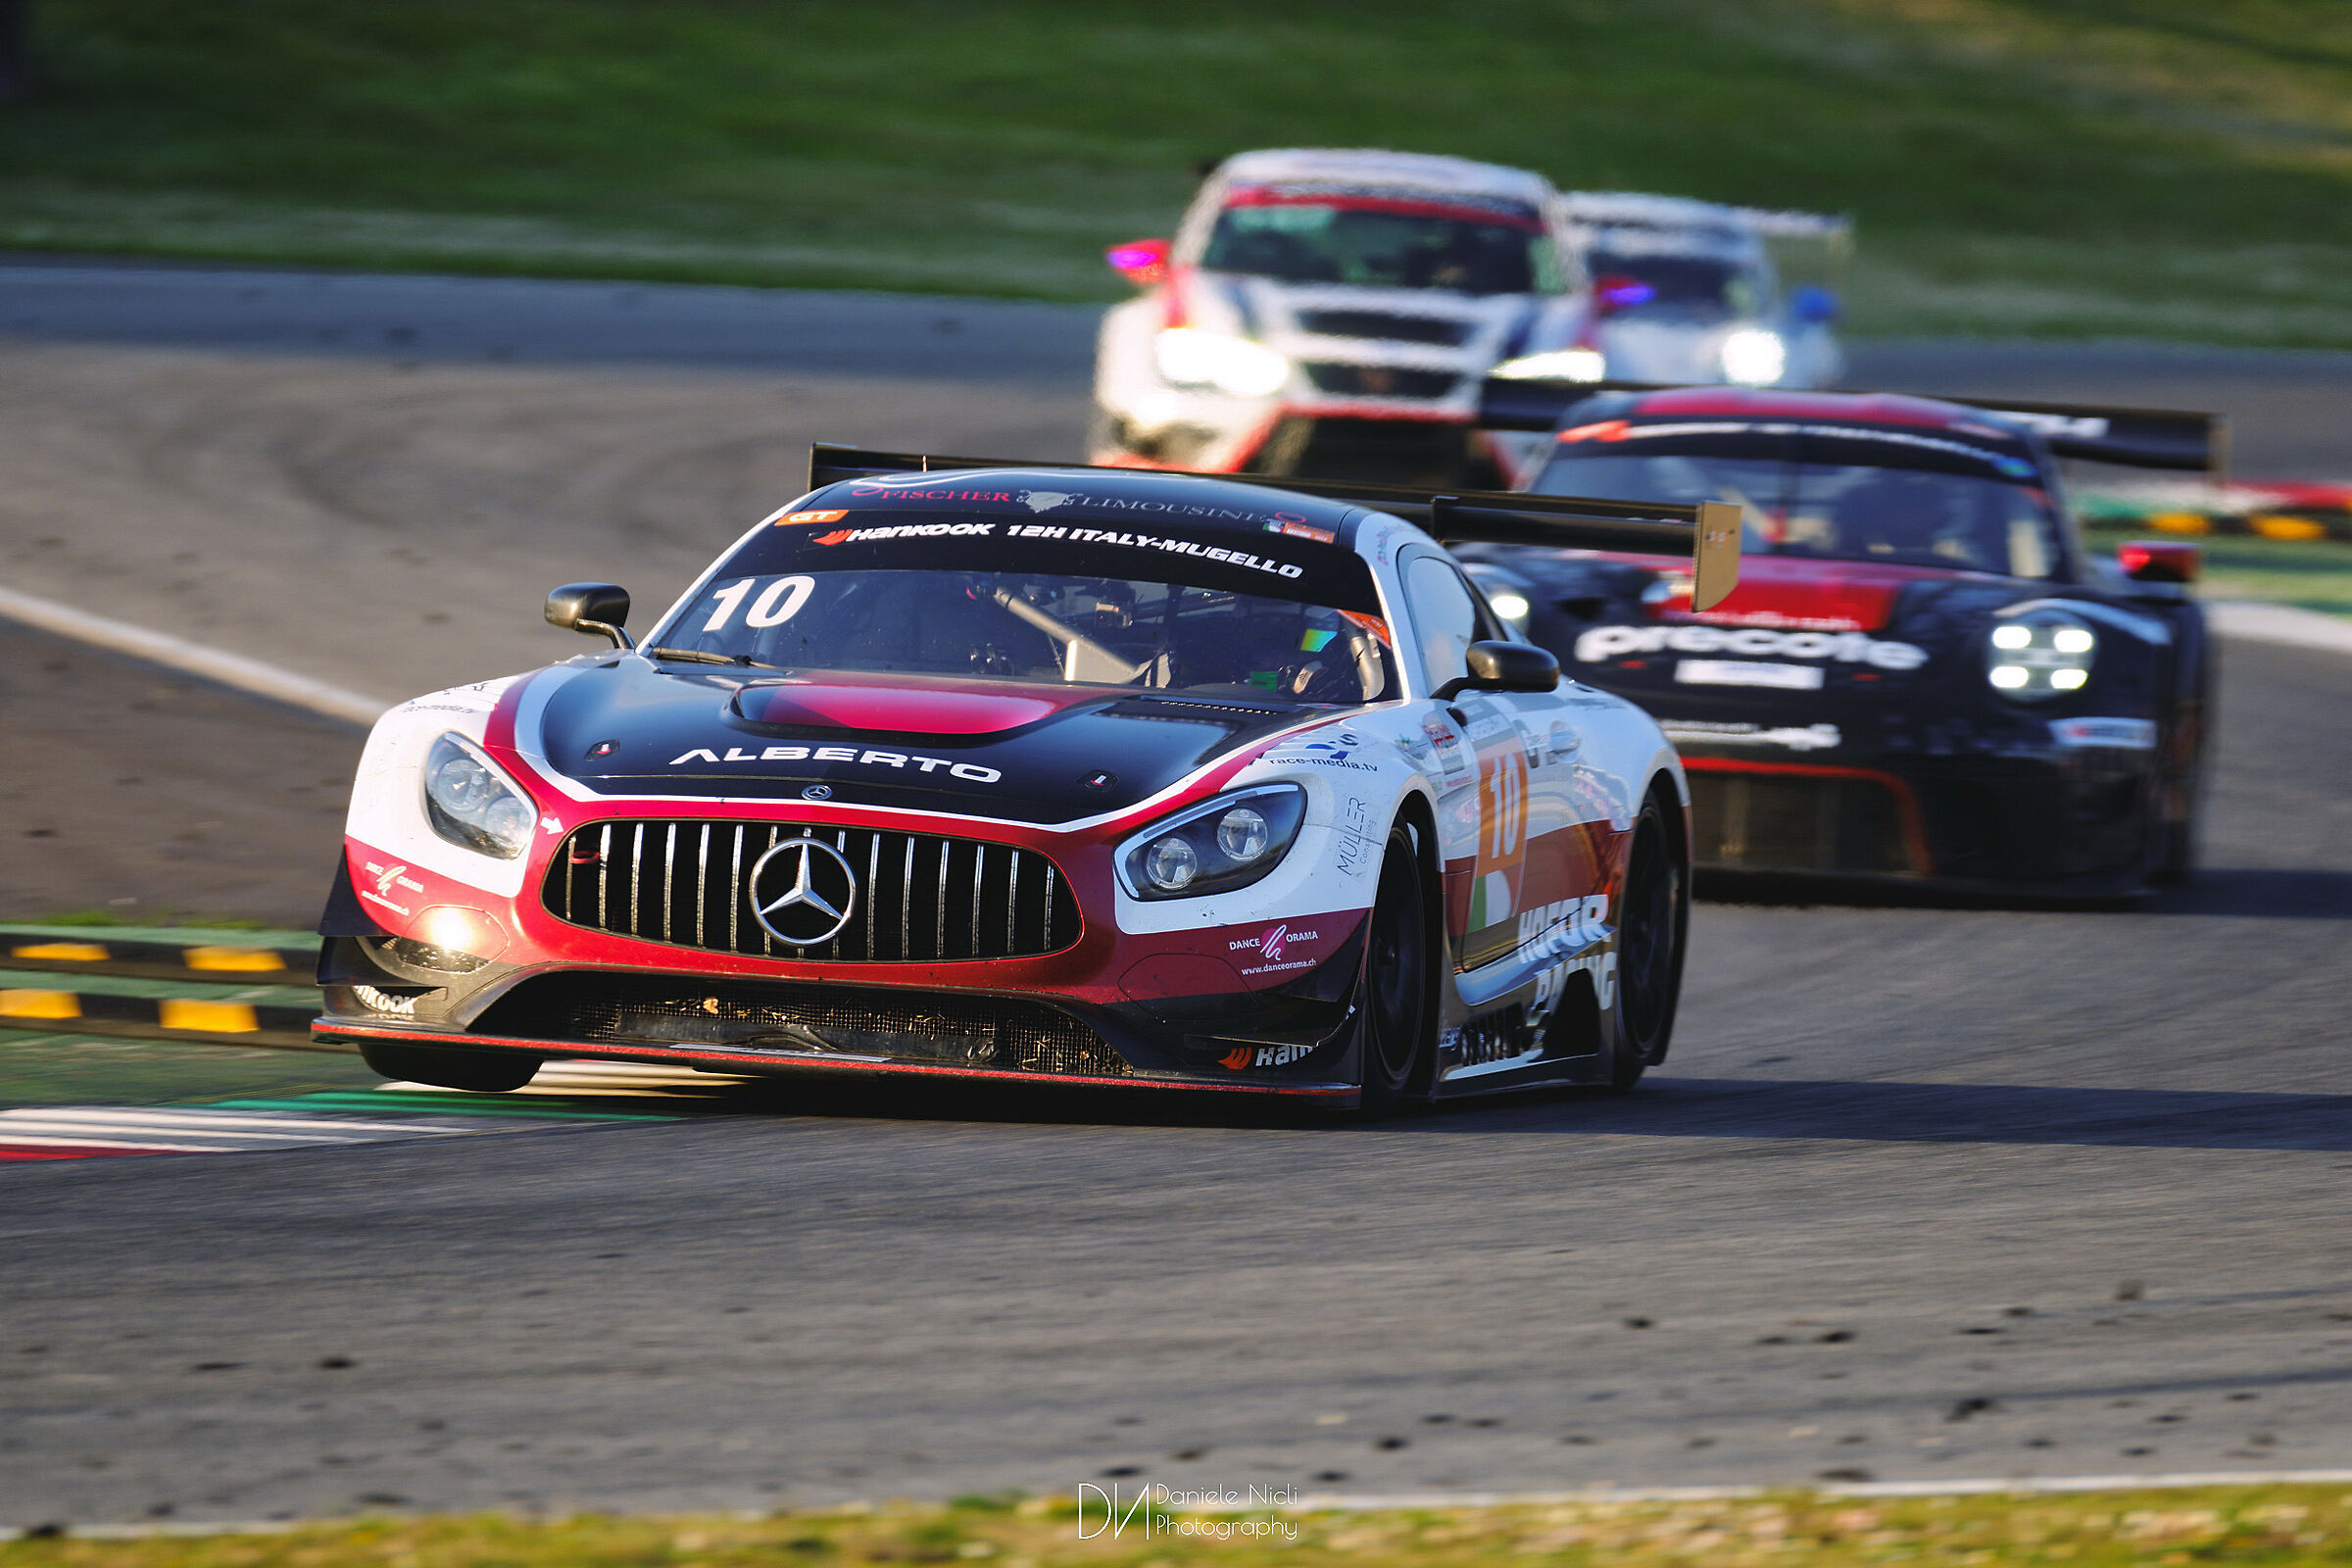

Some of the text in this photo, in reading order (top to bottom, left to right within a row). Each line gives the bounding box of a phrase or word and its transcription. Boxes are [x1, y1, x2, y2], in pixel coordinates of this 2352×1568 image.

[883, 490, 1010, 502] FISCHER
[788, 511, 839, 521] GT
[1007, 524, 1068, 539] 12H
[1068, 528, 1303, 579] ITALY-MUGELLO
[703, 575, 815, 632] 10
[669, 747, 1002, 783] ALBERTO
[1269, 757, 1379, 772] race-media.tv
[1490, 752, 1521, 858] 10
[1337, 797, 1366, 876] MÜLLER
[1229, 931, 1318, 951] DANCE ORAMA
[1241, 958, 1317, 975] www.danceorama.ch
